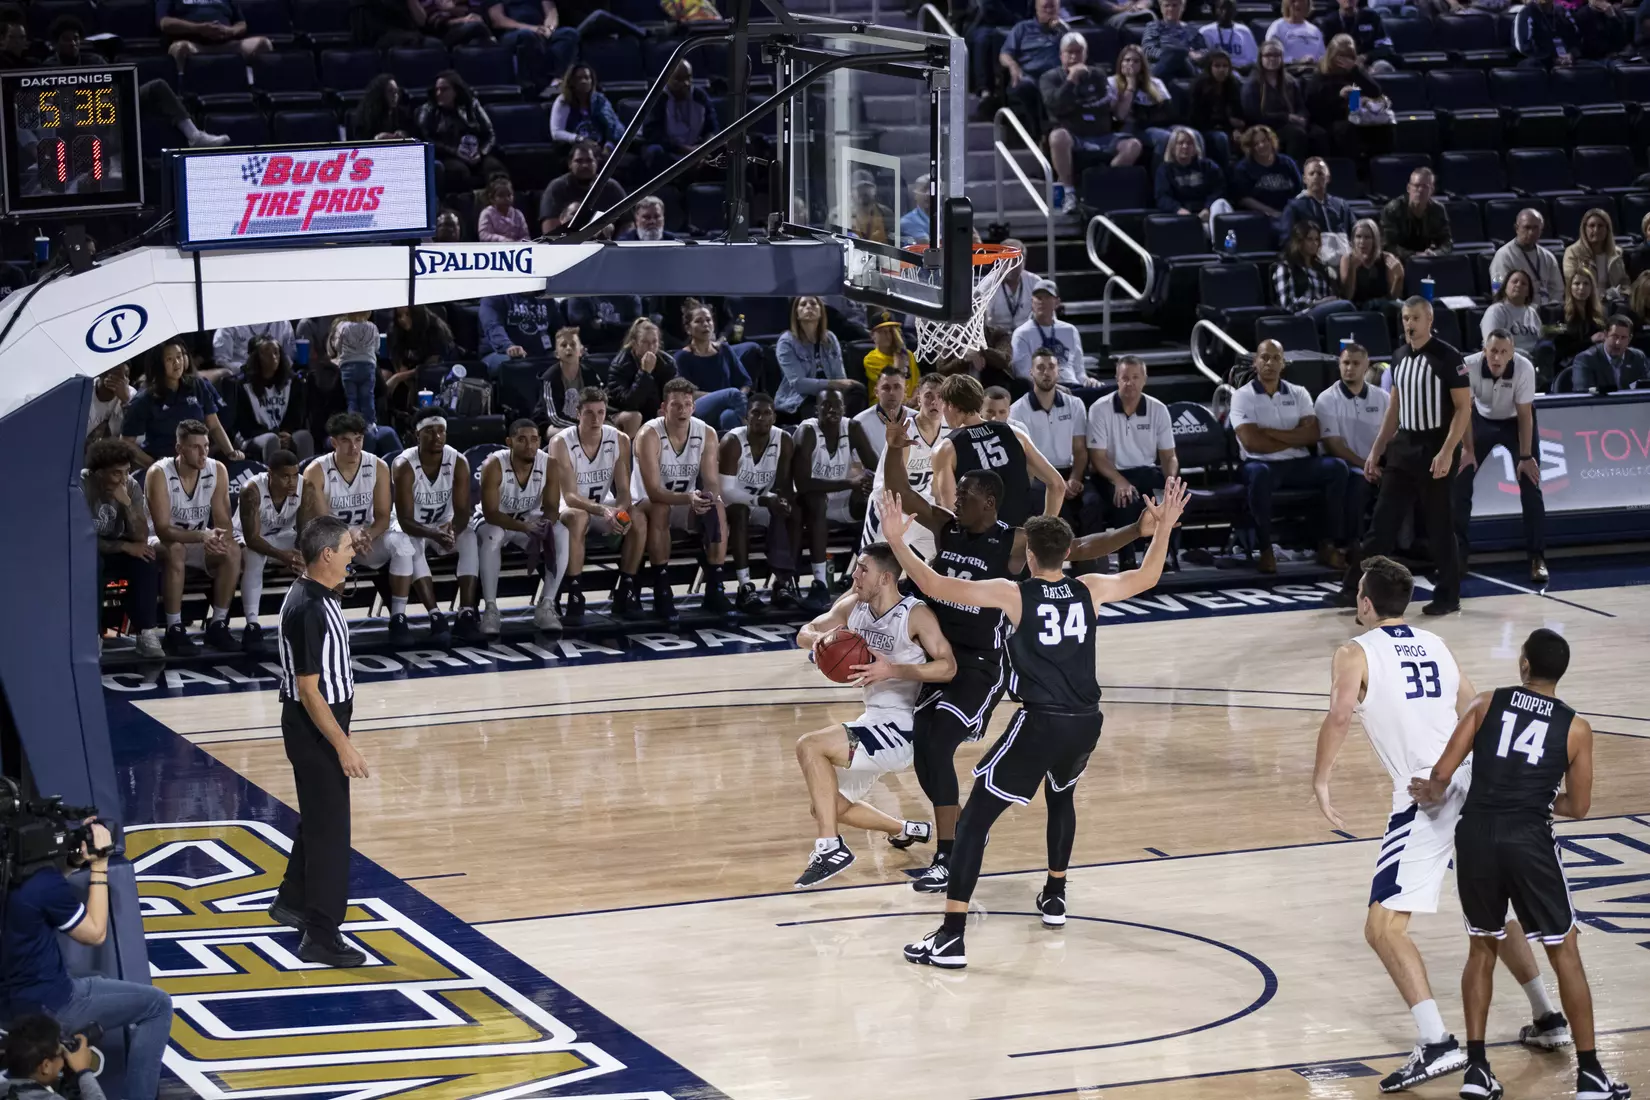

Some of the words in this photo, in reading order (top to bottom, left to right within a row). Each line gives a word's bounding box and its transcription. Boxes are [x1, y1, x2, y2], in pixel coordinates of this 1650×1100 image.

[21, 74, 112, 87] DAKTRONICS
[56, 139, 103, 182] 11
[261, 149, 374, 186] Bud's
[237, 190, 305, 235] TIRE
[301, 186, 385, 231] PROS
[415, 247, 532, 276] SPALDING
[967, 425, 994, 439] KOVAL
[1172, 423, 1208, 435] adidas
[971, 435, 1010, 470] 15
[331, 492, 373, 510] LANCERS
[588, 486, 603, 503] 5
[941, 550, 988, 571] CENTRAL
[1041, 583, 1074, 599] BAKER
[1037, 602, 1088, 645] 34
[1394, 644, 1427, 657] PIROG
[1400, 661, 1442, 700] 33
[1510, 691, 1554, 717] COOPER
[1496, 710, 1550, 766] 14
